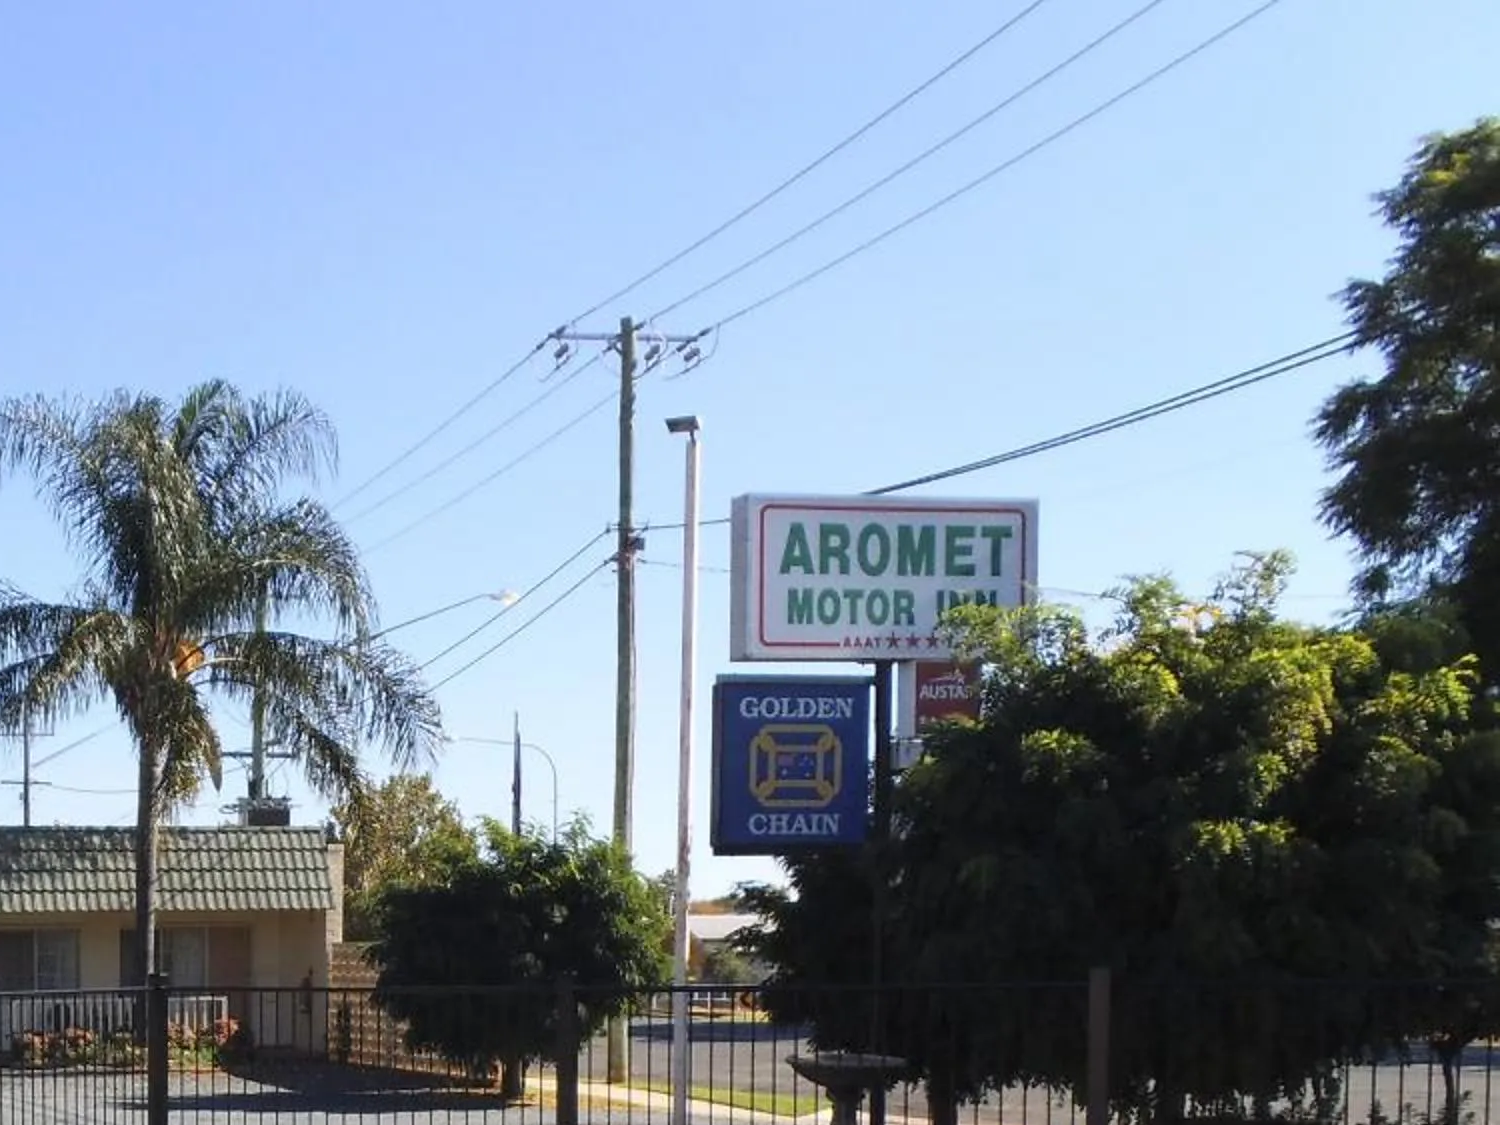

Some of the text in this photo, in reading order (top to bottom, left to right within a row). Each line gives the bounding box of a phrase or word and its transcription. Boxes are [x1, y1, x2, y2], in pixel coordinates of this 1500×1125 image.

[779, 522, 1012, 577] AROMET
[787, 588, 915, 625] MOTOR
[740, 697, 853, 718] GOLDEN
[749, 814, 840, 835] CHAIN
